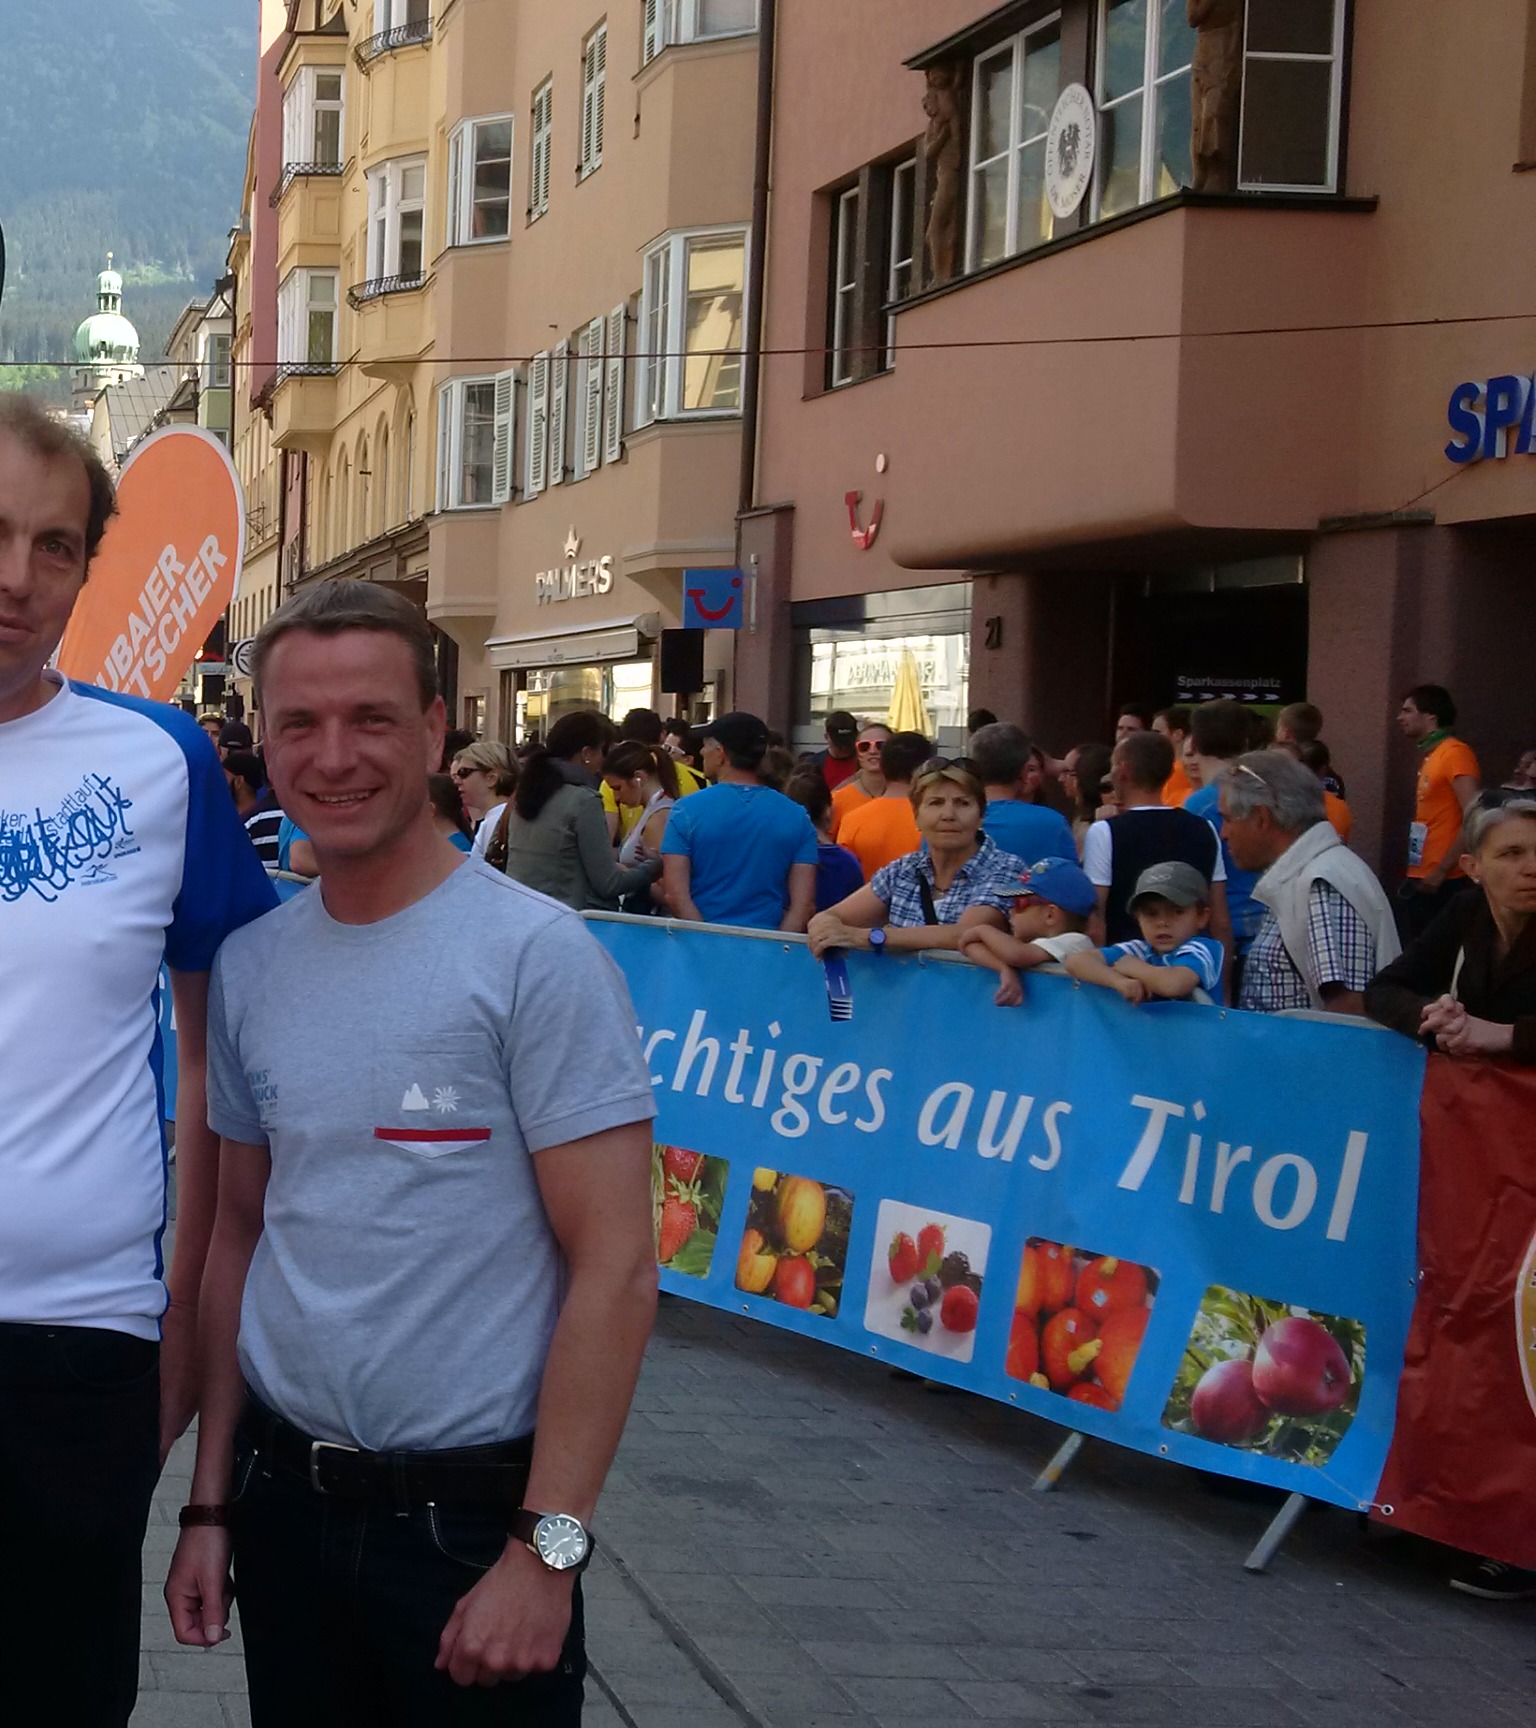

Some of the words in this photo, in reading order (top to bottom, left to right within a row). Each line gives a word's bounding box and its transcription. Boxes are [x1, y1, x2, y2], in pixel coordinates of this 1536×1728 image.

[535, 555, 613, 606] PALMERS
[1177, 675, 1282, 689] Sparkassenplatz
[46, 774, 96, 836] stadtlauf
[636, 1009, 893, 1138] chtiges
[917, 1081, 1072, 1172] aus
[1117, 1094, 1369, 1243] Tirol
